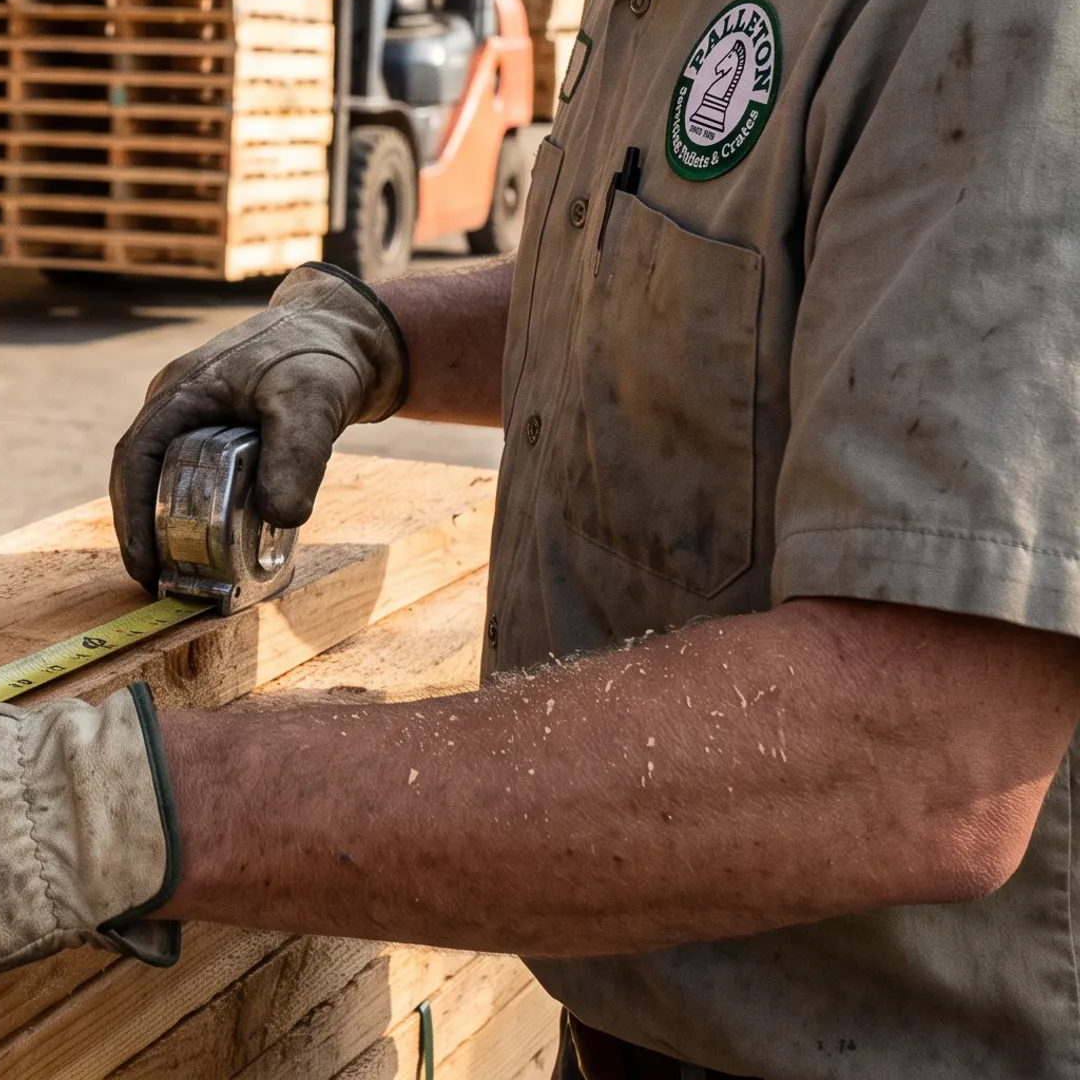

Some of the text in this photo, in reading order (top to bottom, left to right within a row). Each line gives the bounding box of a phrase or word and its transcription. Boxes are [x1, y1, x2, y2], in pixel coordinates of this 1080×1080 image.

[689, 8, 772, 93] PALLETON
[710, 150, 720, 166] &
[721, 109, 759, 158] Crates
